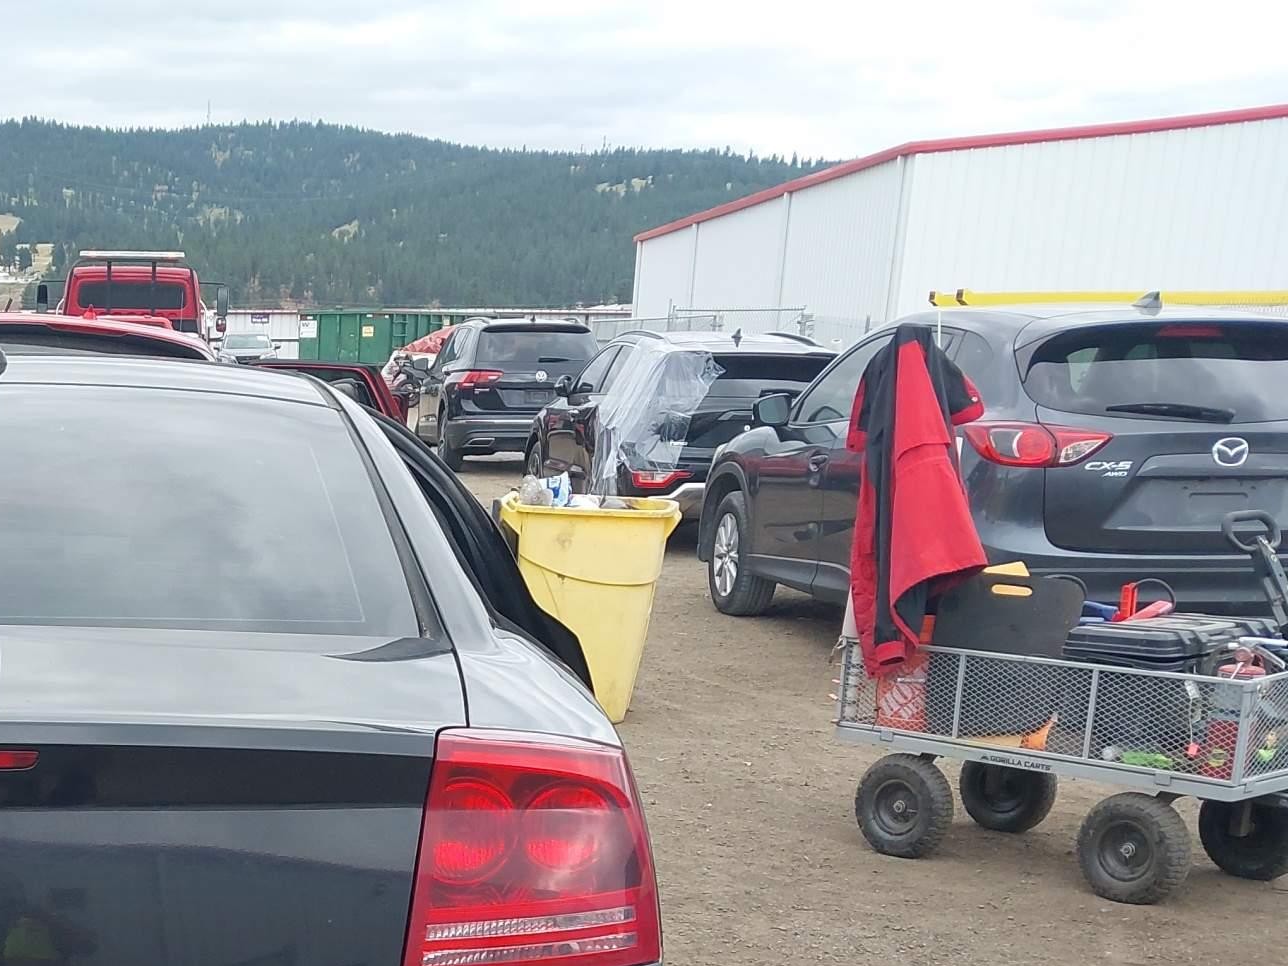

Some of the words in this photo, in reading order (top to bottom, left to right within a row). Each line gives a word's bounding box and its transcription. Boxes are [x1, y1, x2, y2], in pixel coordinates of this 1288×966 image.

[1084, 461, 1133, 471] CX-5
[990, 755, 1022, 767] GORILLA
[1023, 760, 1051, 771] CARTS
